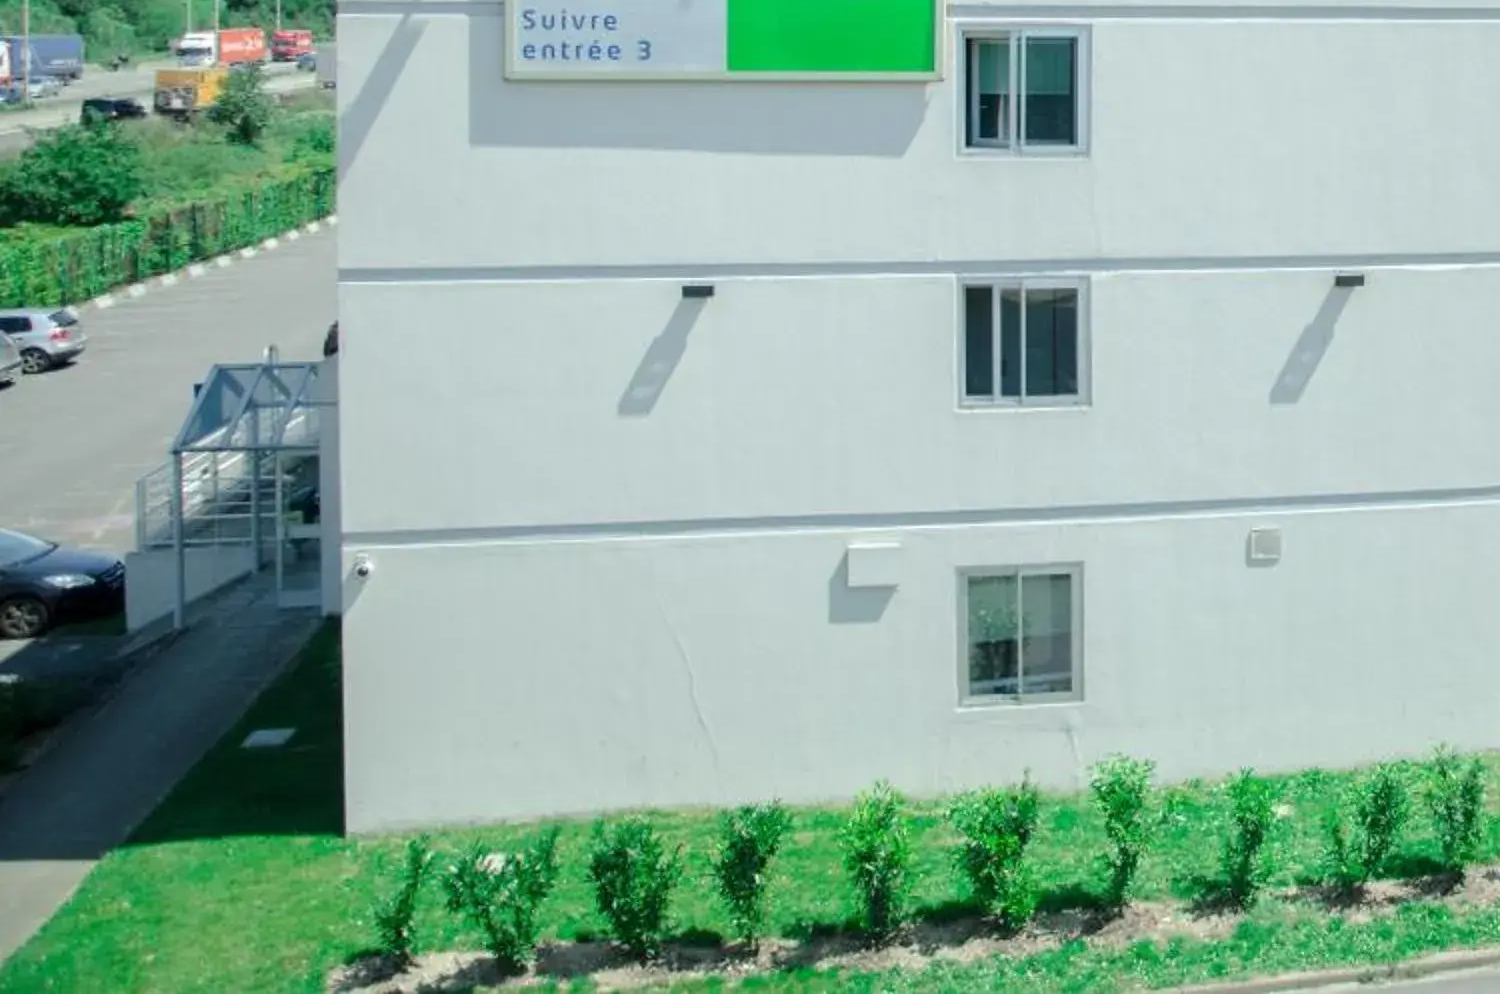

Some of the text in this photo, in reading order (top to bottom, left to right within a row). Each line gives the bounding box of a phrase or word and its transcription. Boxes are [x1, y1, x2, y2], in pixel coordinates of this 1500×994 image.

[522, 10, 619, 32] Suivre
[522, 39, 652, 61] entrée 3
